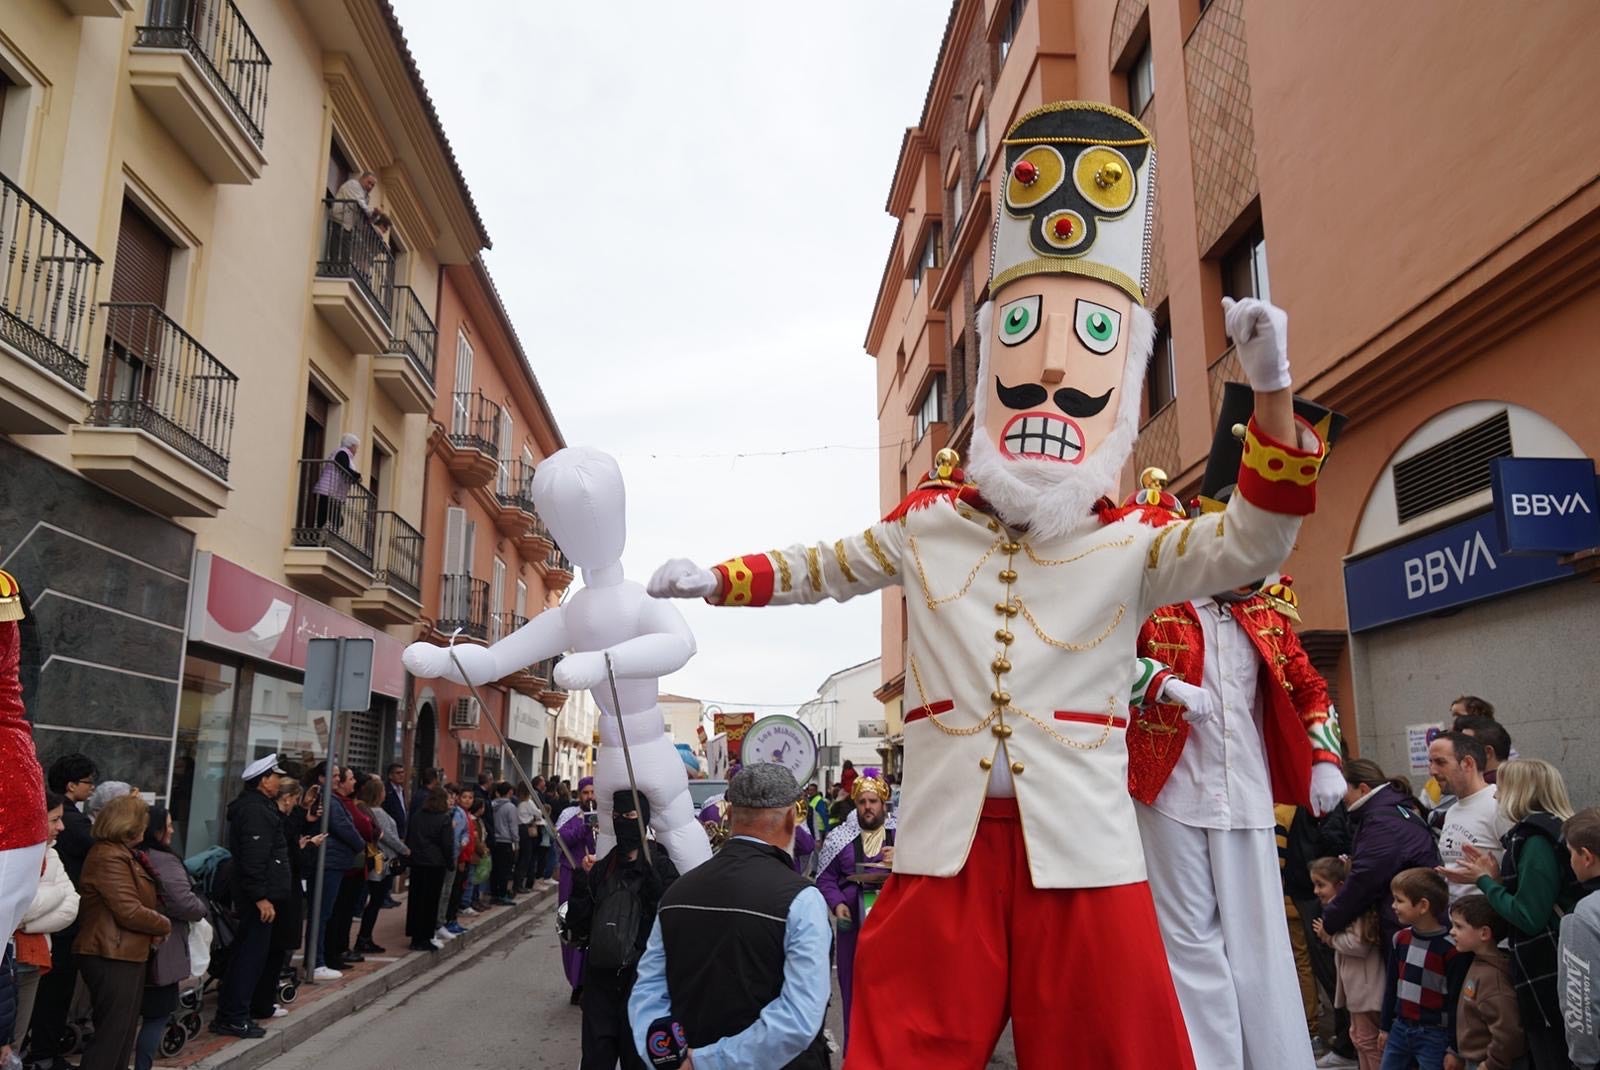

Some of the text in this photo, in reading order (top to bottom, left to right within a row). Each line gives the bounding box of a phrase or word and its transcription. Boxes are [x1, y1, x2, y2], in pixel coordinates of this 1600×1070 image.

[1511, 492, 1591, 516] BBVA
[1404, 530, 1497, 600] BBVA
[1562, 943, 1591, 1034] LAKERS
